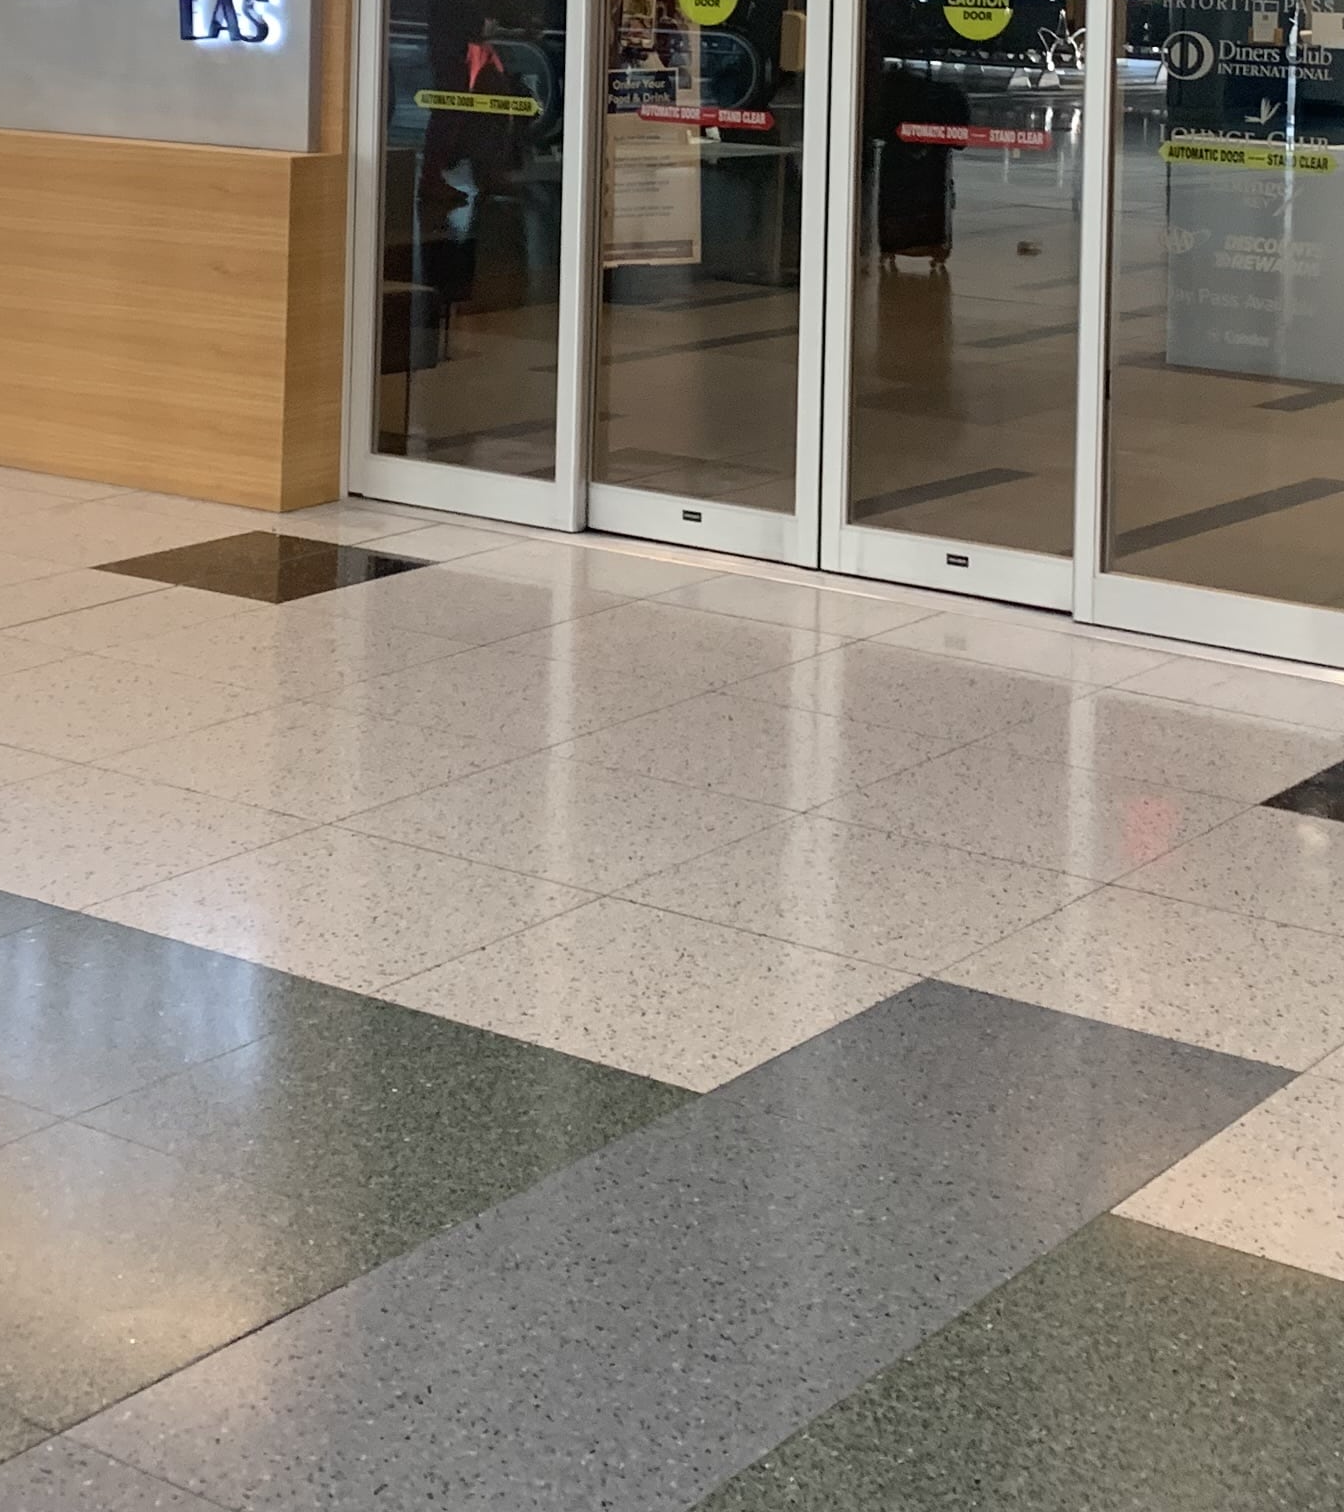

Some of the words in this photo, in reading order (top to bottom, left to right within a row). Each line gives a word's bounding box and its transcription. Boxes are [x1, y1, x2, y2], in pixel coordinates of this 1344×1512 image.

[963, 10, 993, 21] DOOR
[1218, 40, 1280, 64] Diners
[1286, 43, 1333, 66] Club
[1217, 62, 1333, 81] INTERNATONAL
[643, 79, 666, 89] Your
[608, 93, 631, 104] Food
[643, 92, 670, 103] Drink
[641, 104, 680, 118] AUTOMATIC
[681, 107, 701, 119] DOOR
[718, 110, 741, 123] STAND
[742, 111, 766, 124] CLEAR
[901, 123, 945, 138] AUTOMATIC
[947, 126, 968, 139] DOOR
[989, 129, 1016, 142] STAND
[1017, 131, 1044, 144] CLEAR
[1267, 130, 1329, 151] CUB
[1167, 145, 1218, 162] AUTOMATIC
[1220, 150, 1245, 164] DOOR
[1267, 155, 1296, 168] STAD
[1298, 156, 1329, 170] CLEAR
[1223, 233, 1325, 259] DISCONTS
